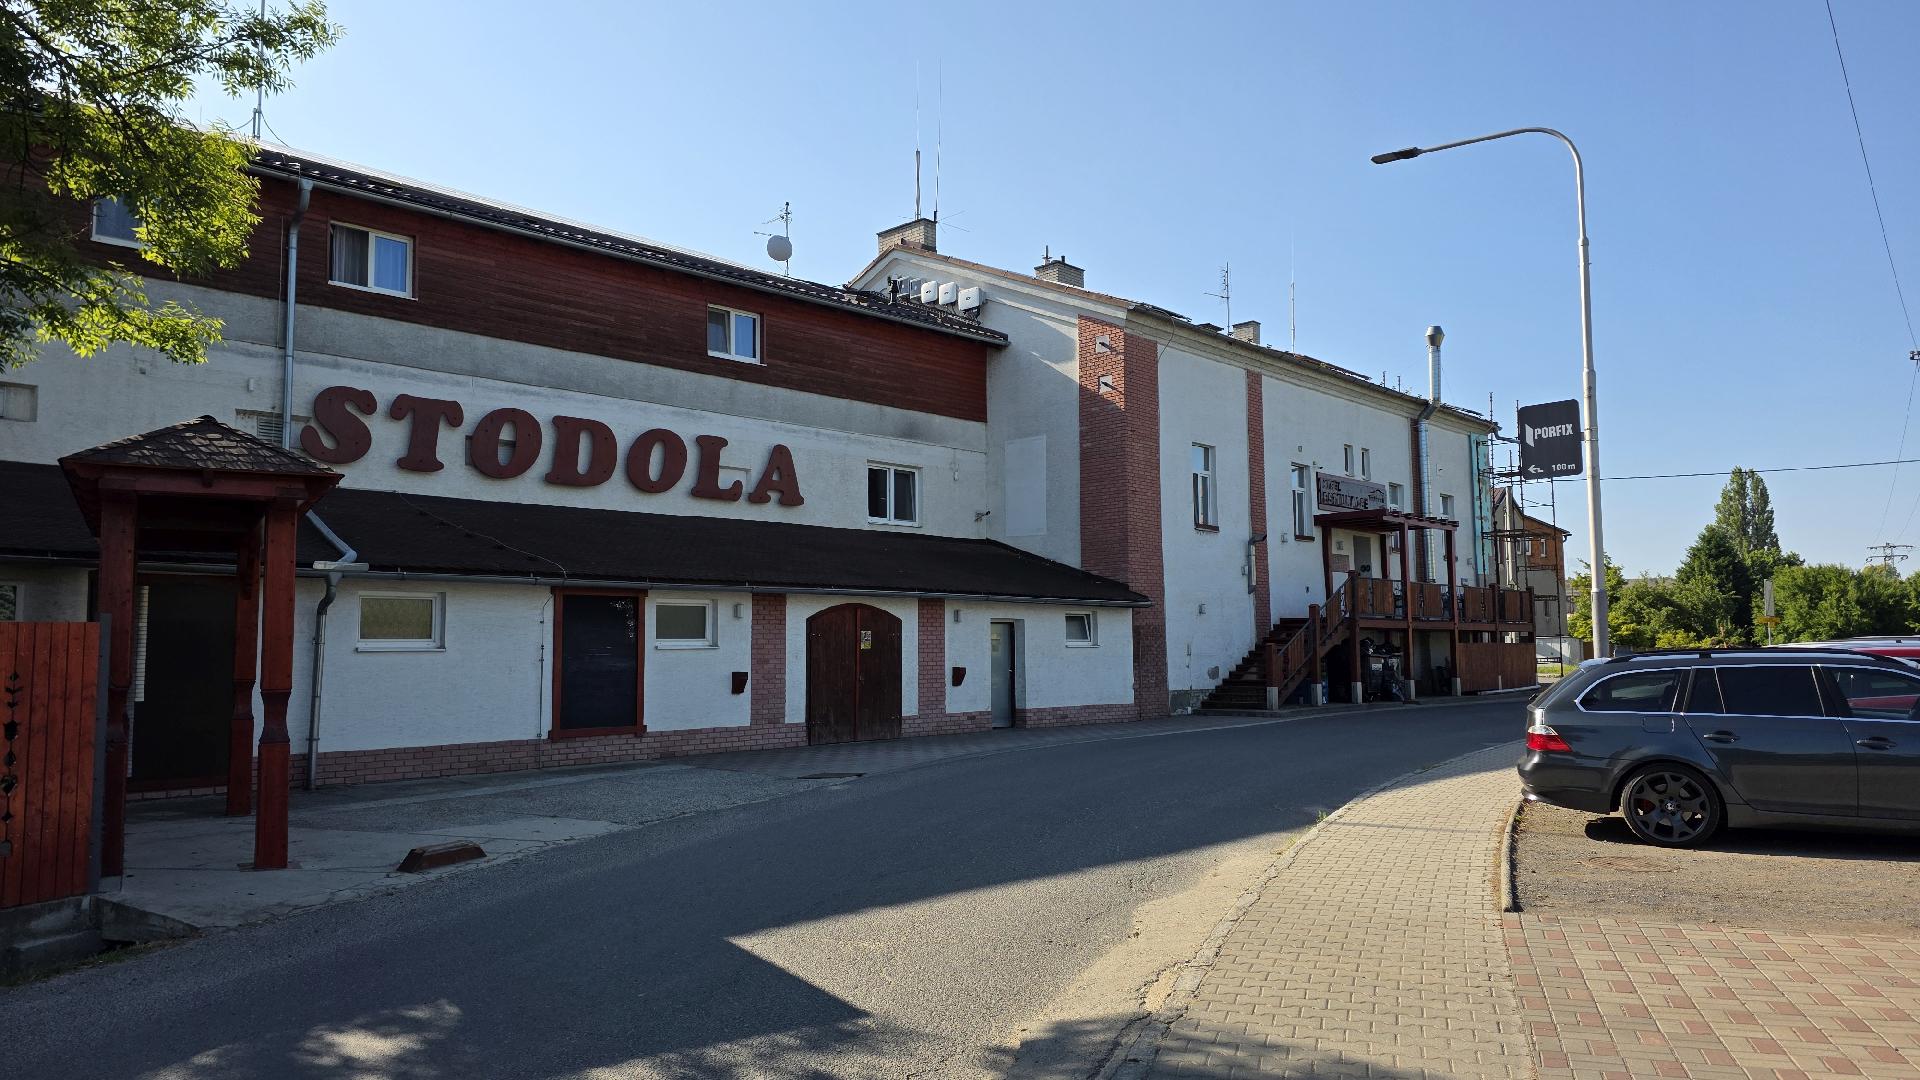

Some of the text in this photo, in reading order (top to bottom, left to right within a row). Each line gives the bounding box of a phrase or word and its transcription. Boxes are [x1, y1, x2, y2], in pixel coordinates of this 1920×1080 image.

[1534, 423, 1574, 440] PORFIX
[301, 385, 805, 507] STODOLA
[1551, 464, 1567, 472] 100
